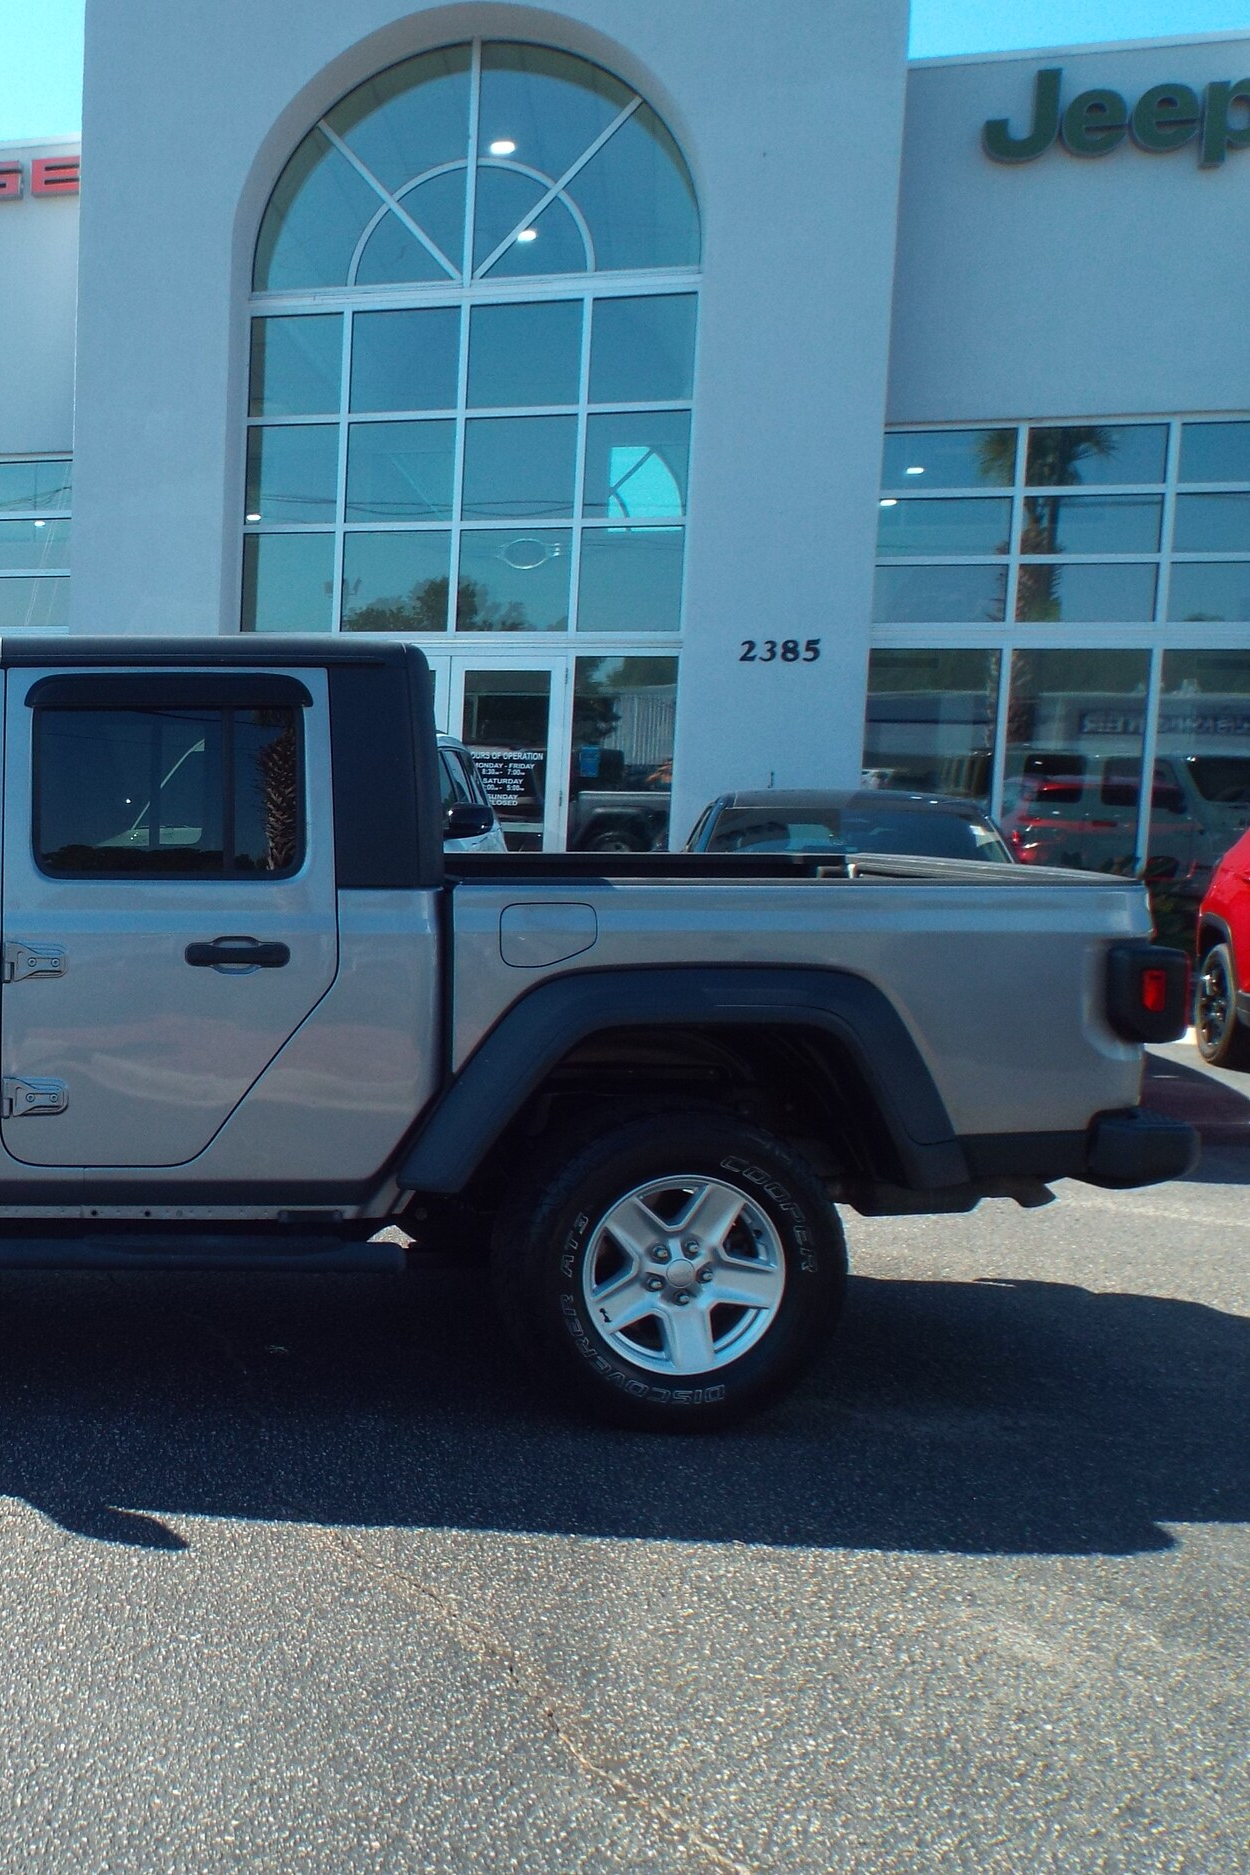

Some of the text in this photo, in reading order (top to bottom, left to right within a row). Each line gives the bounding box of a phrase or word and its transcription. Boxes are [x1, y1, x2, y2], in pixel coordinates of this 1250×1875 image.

[982, 67, 1250, 170] Jeep
[738, 638, 821, 662] 2385
[471, 751, 544, 760] OURS OF OPERATION
[720, 1155, 818, 1273] COOPER
[560, 1211, 725, 1405] DISCOVERER AT3
